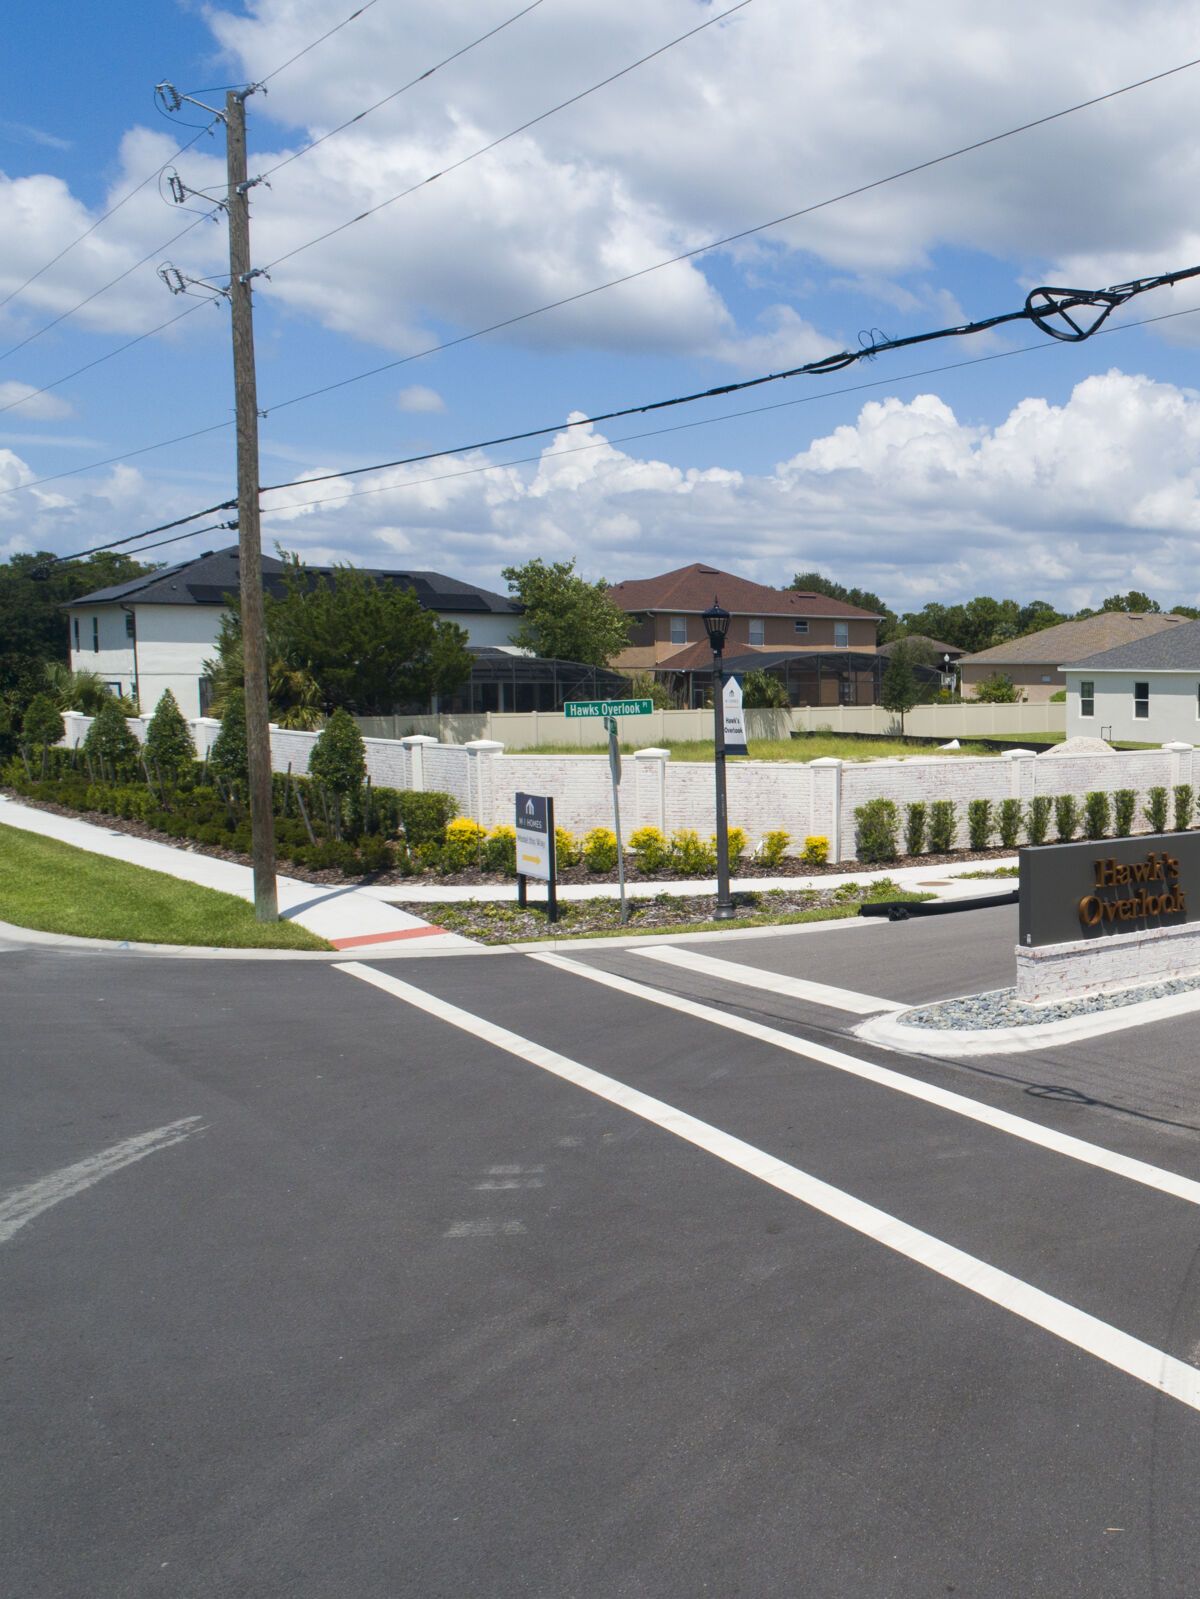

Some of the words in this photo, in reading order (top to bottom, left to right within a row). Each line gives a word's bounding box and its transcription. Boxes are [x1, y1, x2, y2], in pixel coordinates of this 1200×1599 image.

[570, 703, 600, 716] Hawks
[601, 702, 641, 715] Overlook
[1091, 851, 1181, 888] Hawk's
[1078, 883, 1186, 927] Overlook
